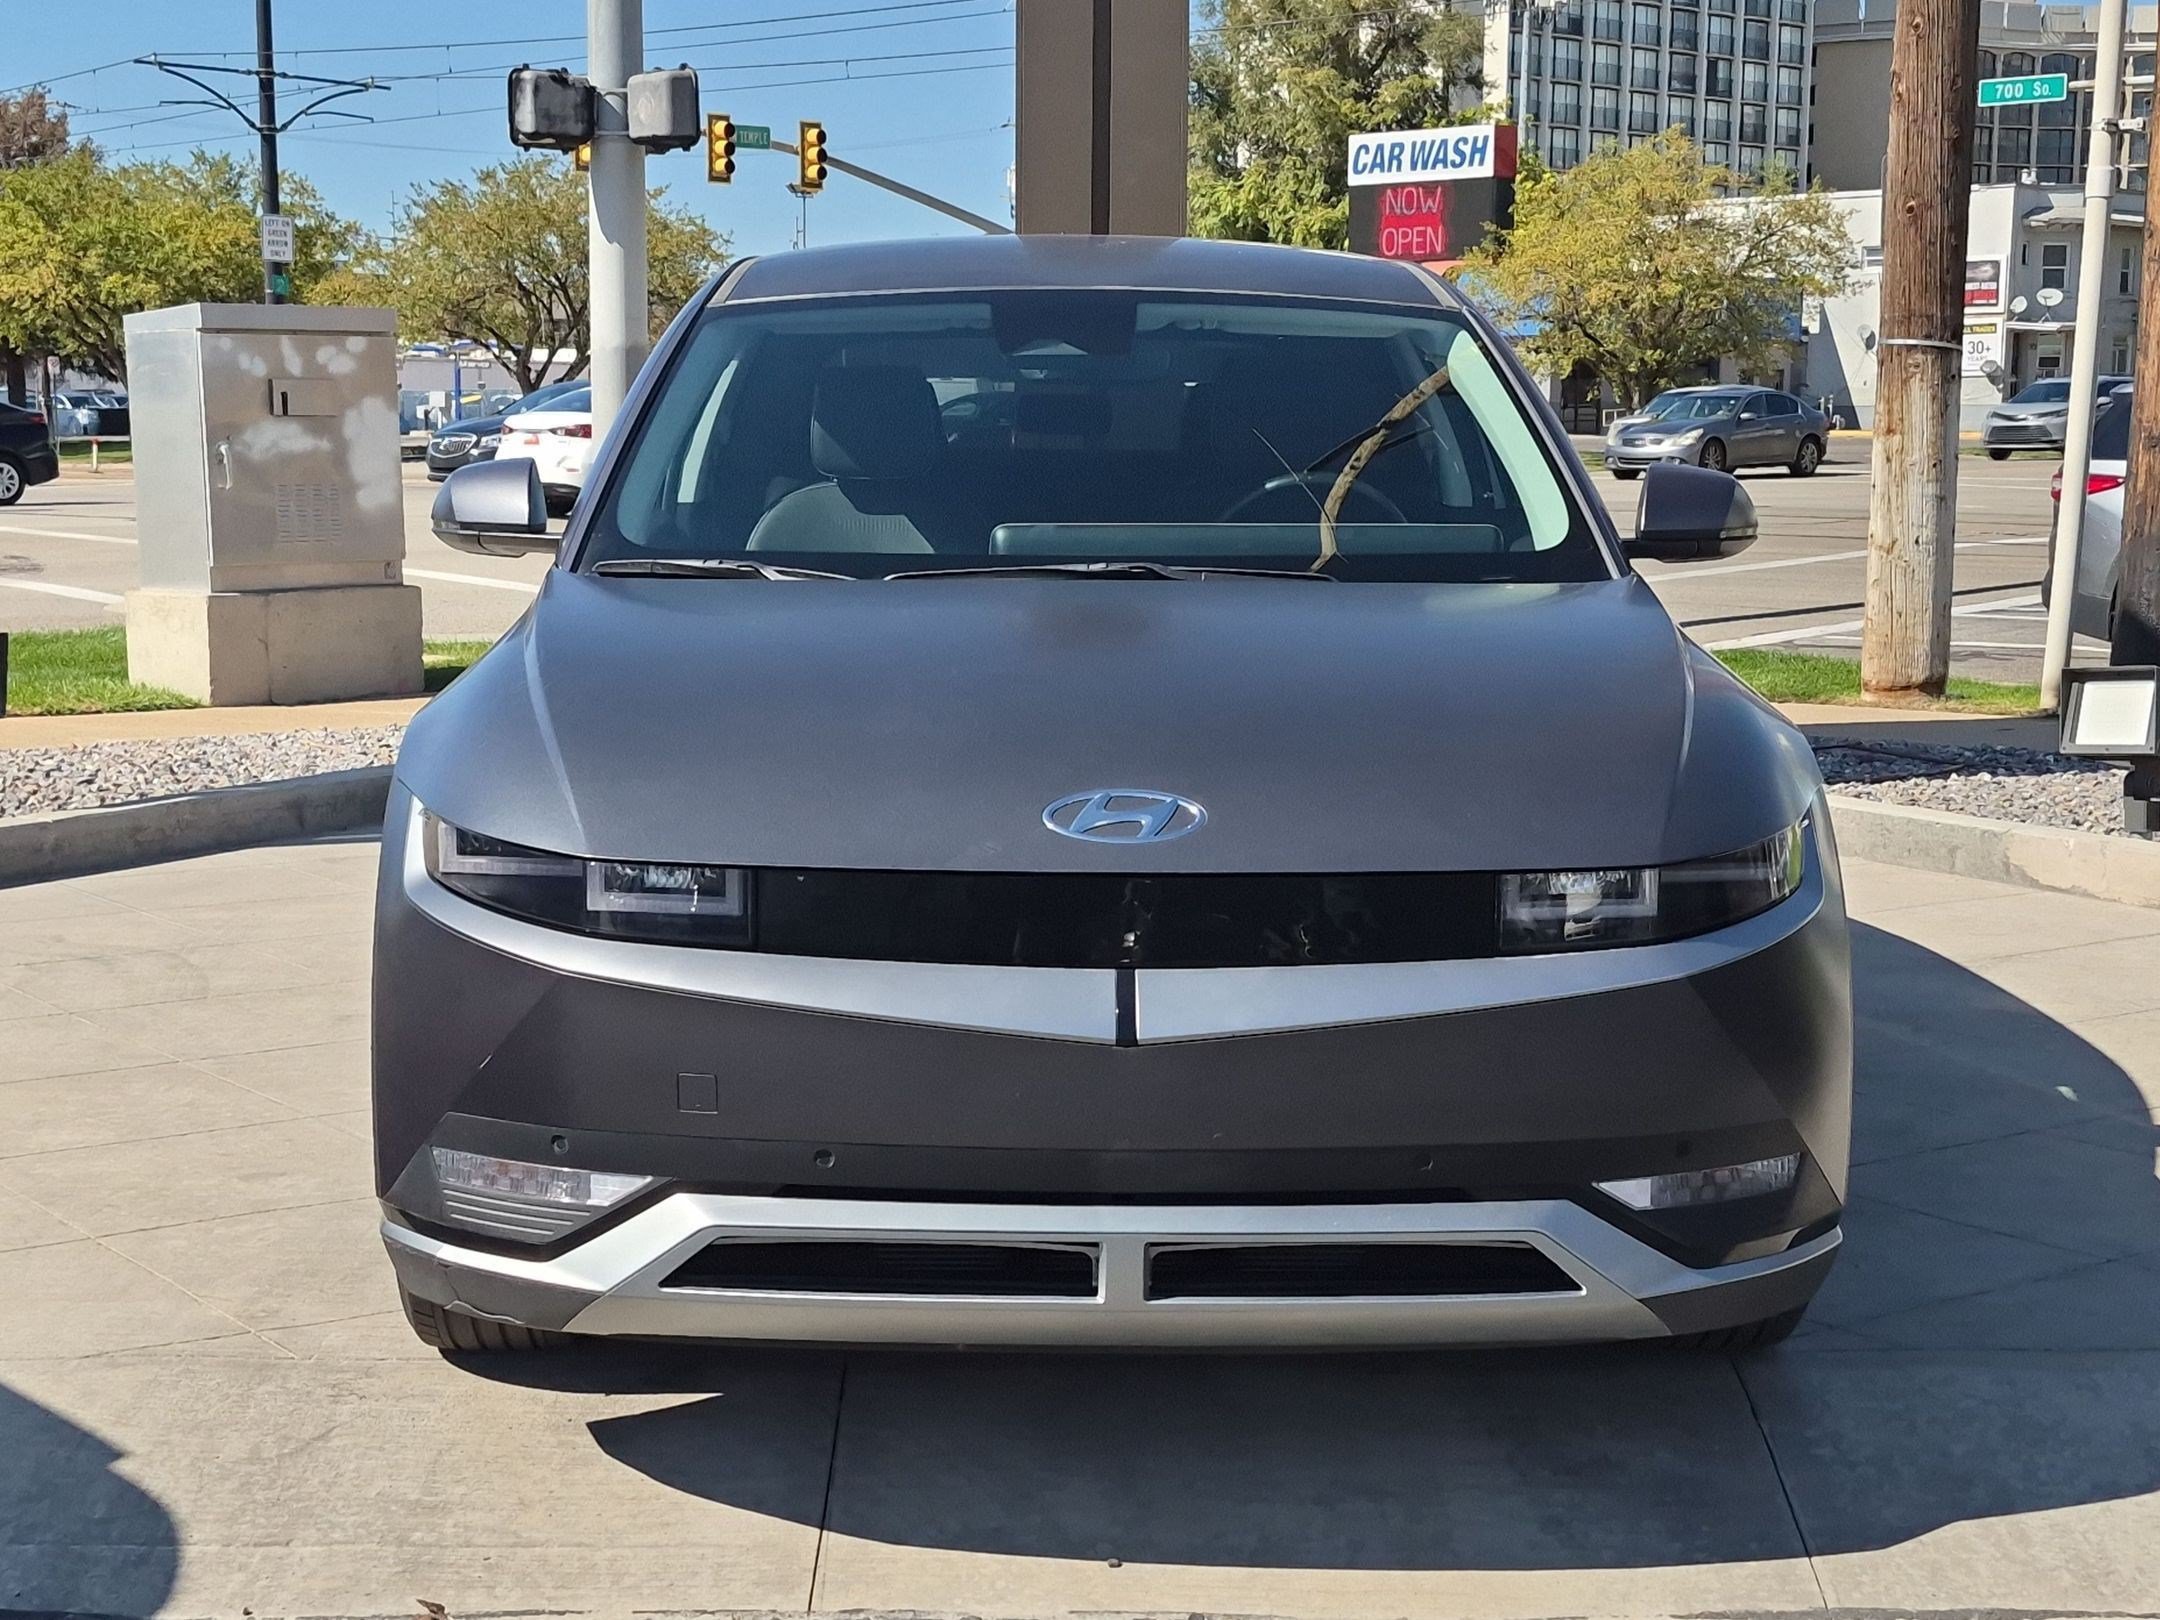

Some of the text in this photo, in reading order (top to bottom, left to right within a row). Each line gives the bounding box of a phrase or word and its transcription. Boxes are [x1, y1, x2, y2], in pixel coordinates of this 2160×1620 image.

[1995, 81, 2051, 99] 700 So.
[739, 130, 768, 145] TEMPLE
[1352, 135, 1490, 175] CAR WASH
[1385, 186, 1442, 215] NOW
[1381, 226, 1442, 257] OPEN
[270, 249, 286, 258] ONLY
[1967, 340, 1992, 355] 30+
